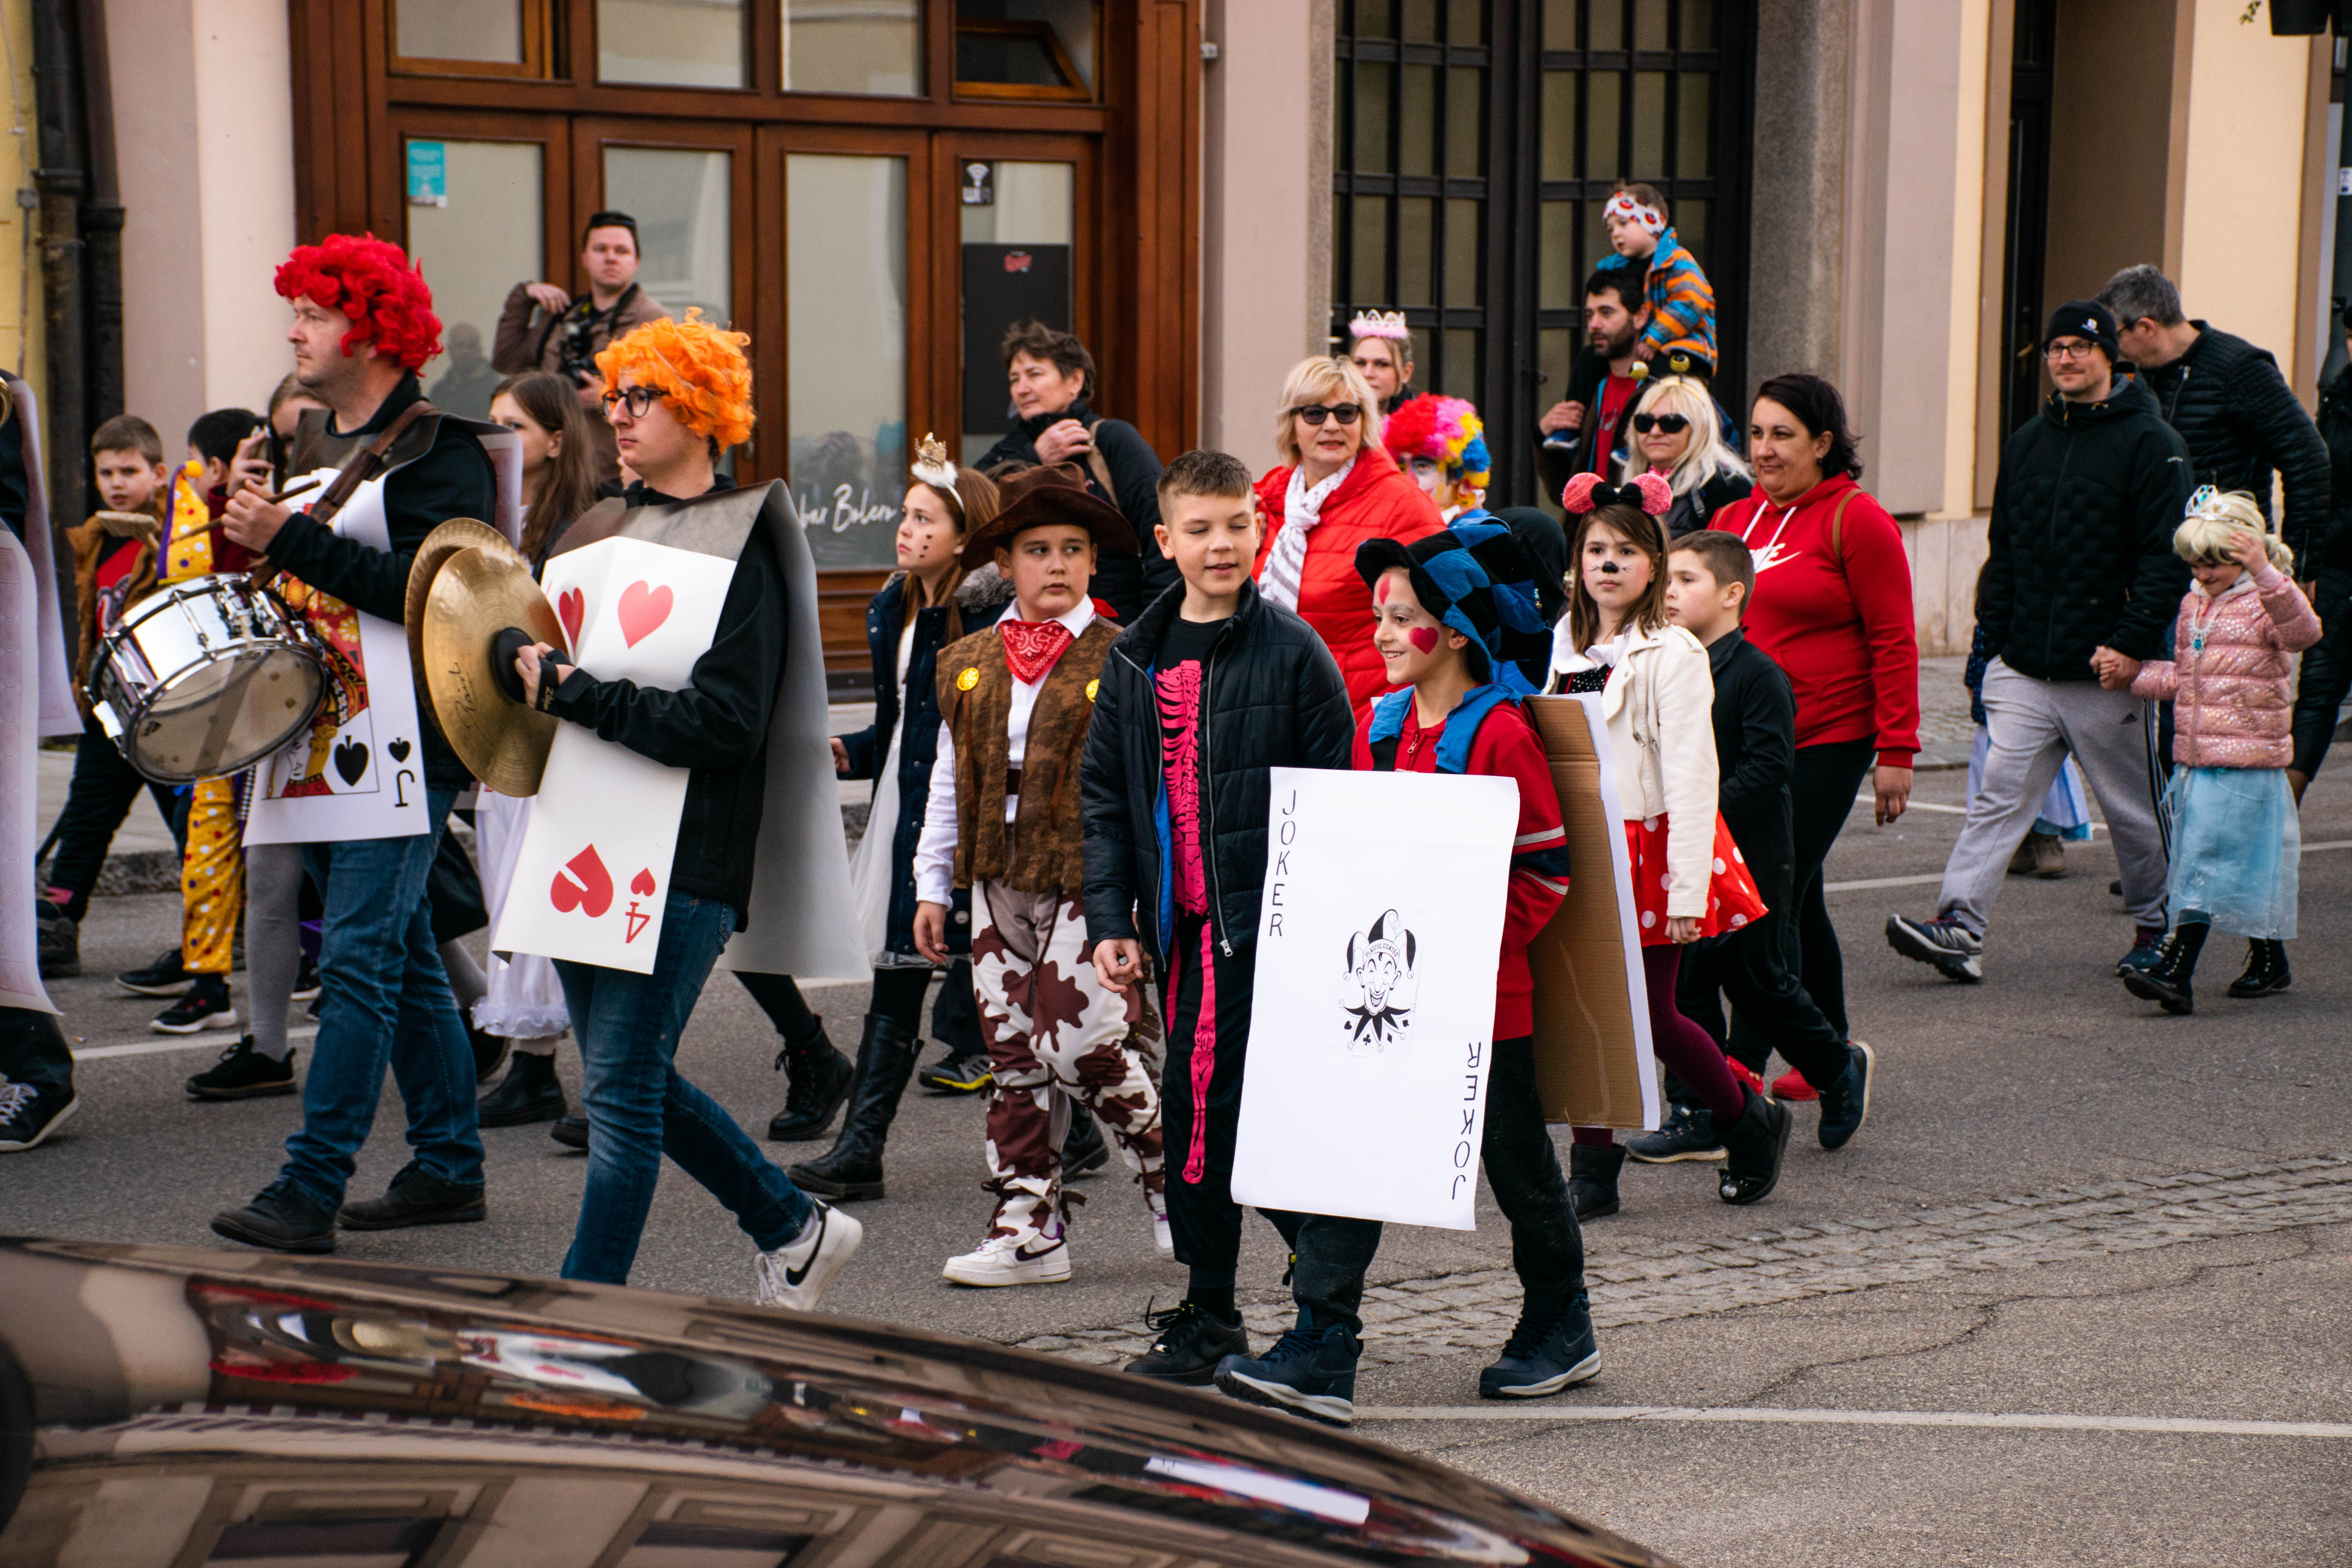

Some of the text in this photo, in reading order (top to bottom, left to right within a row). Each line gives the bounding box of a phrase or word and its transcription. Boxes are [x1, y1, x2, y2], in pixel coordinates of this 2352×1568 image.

[394, 769, 415, 808] J
[1269, 789, 1297, 937] JOKER
[624, 901, 652, 944] 4
[1365, 942, 1399, 957] PLASTIC COATED
[1451, 1041, 1482, 1201] JOKER
